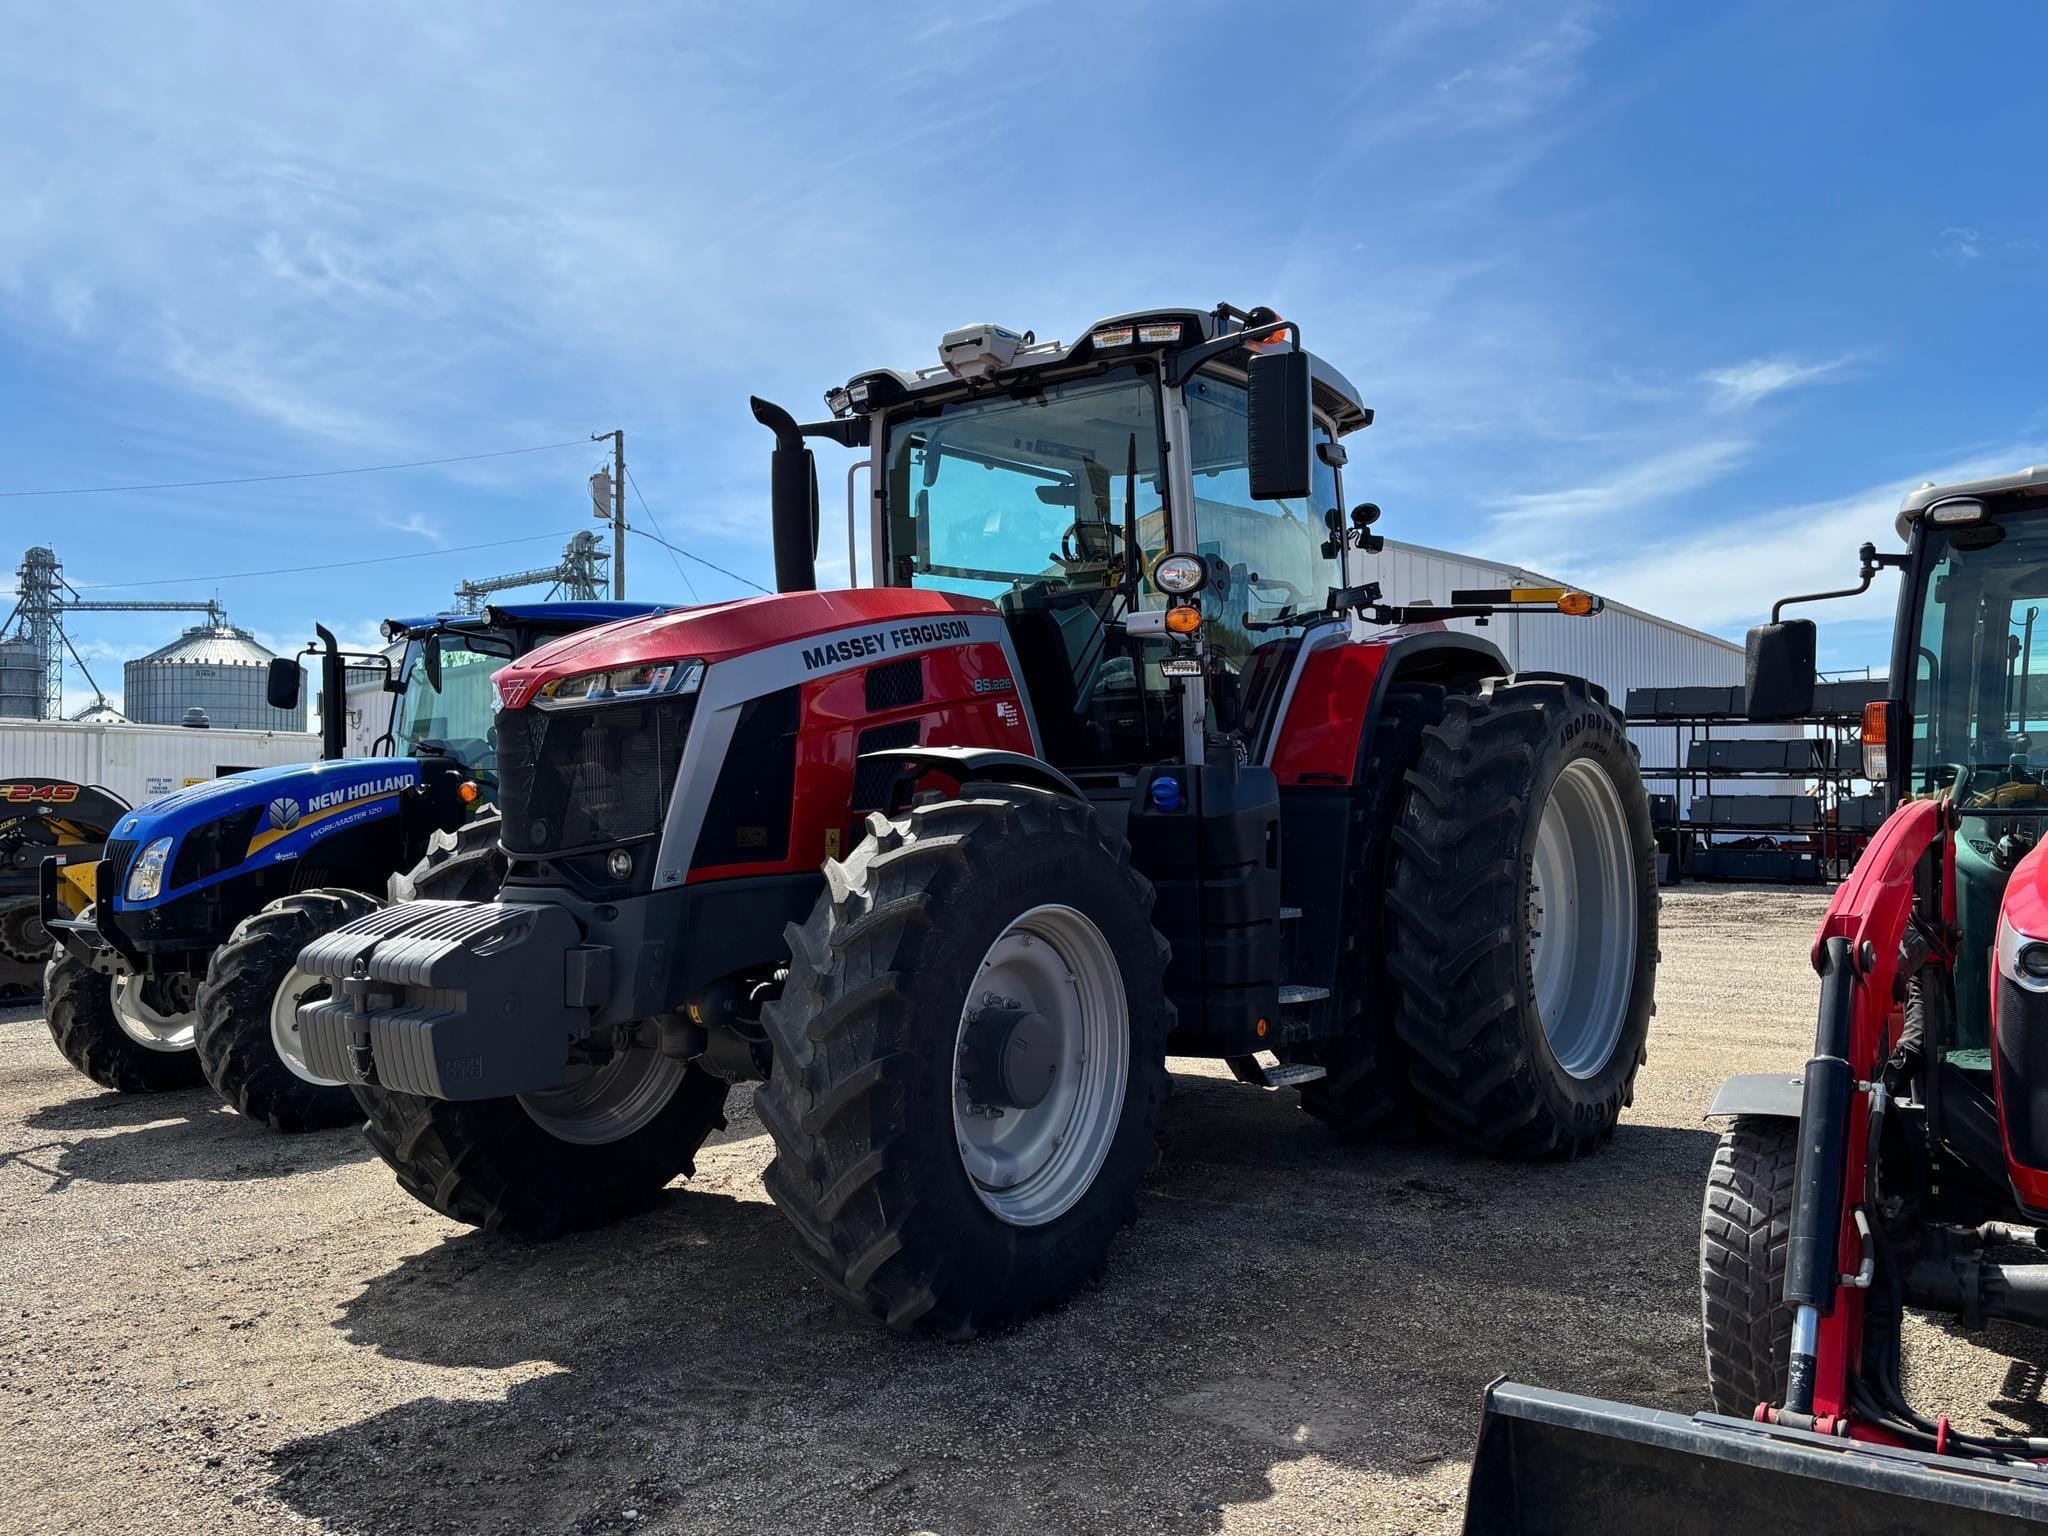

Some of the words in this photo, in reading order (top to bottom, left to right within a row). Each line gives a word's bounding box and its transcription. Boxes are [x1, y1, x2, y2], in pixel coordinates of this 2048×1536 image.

[802, 632, 886, 671] MASSEY
[890, 620, 971, 649] FERGUSON
[974, 678, 1012, 693] 8S.225
[7, 784, 80, 803] 245
[308, 789, 346, 813] NEW
[348, 774, 415, 801] HOLLAND
[310, 811, 368, 839] WORKMASTER
[369, 806, 383, 816] 120
